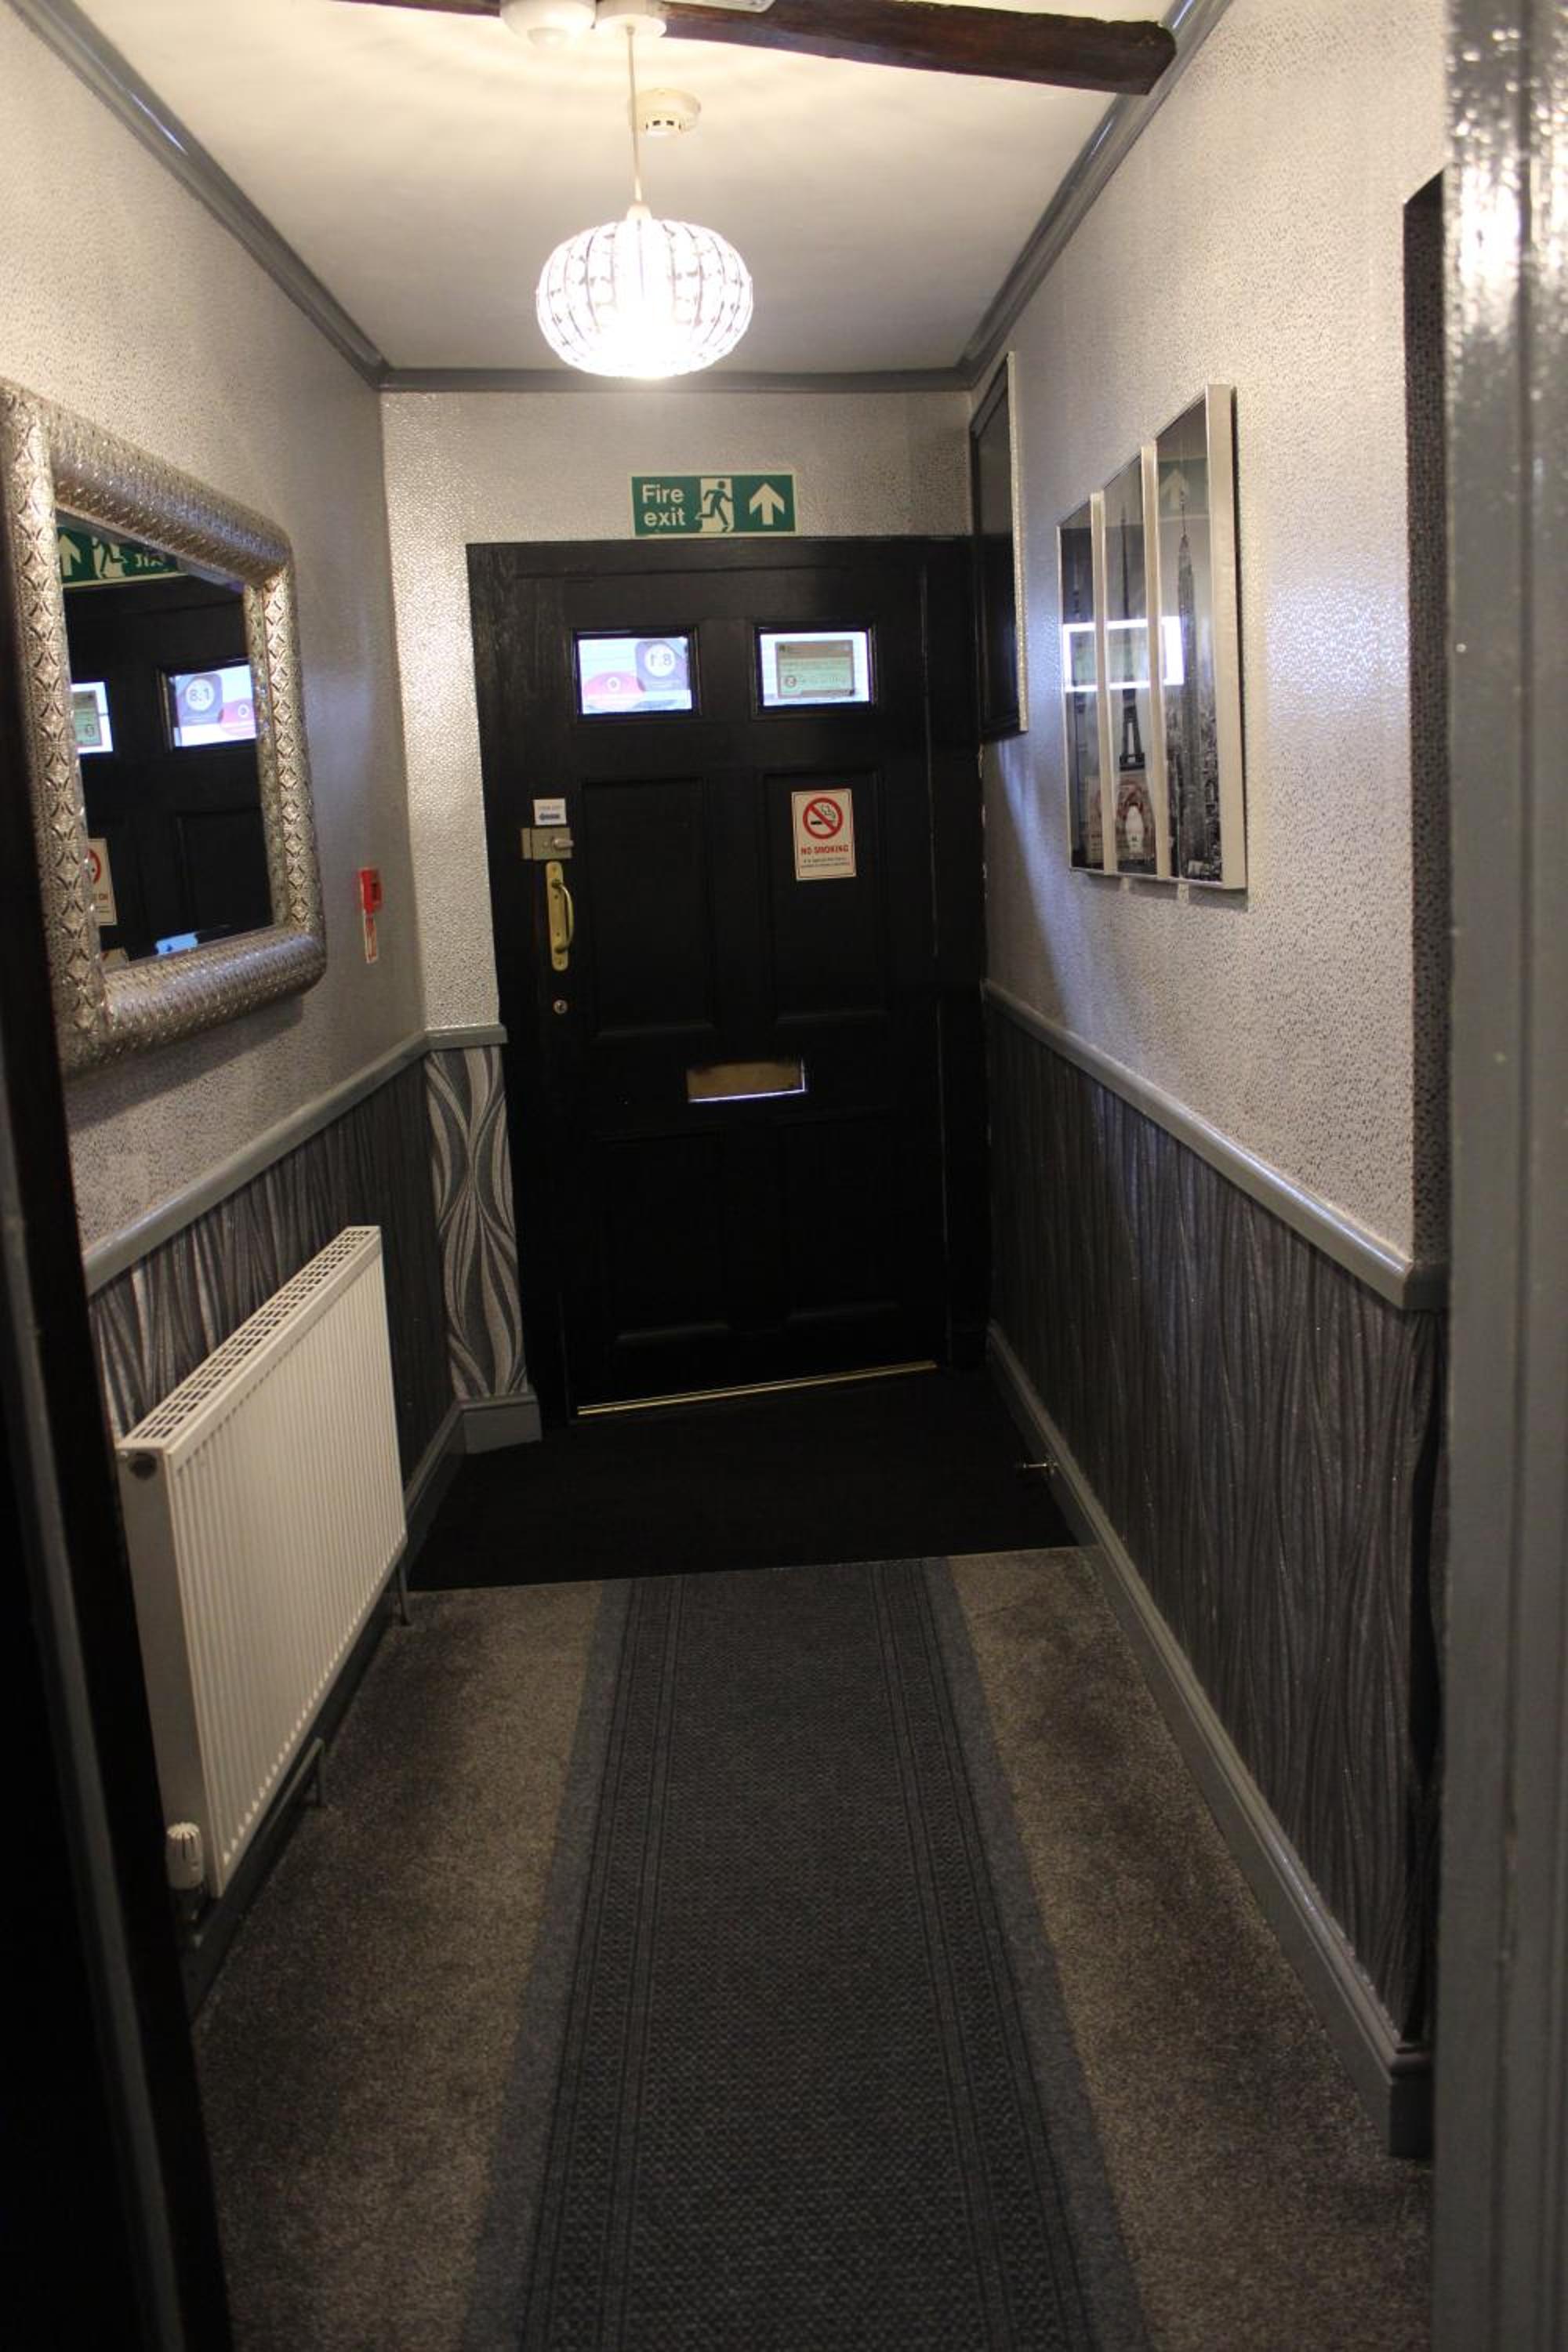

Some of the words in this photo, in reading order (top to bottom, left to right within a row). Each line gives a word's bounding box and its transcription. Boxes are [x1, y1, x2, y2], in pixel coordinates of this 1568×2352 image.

[642, 484, 684, 503] Fire
[644, 508, 686, 526] exit
[814, 844, 849, 853] SMOKING
